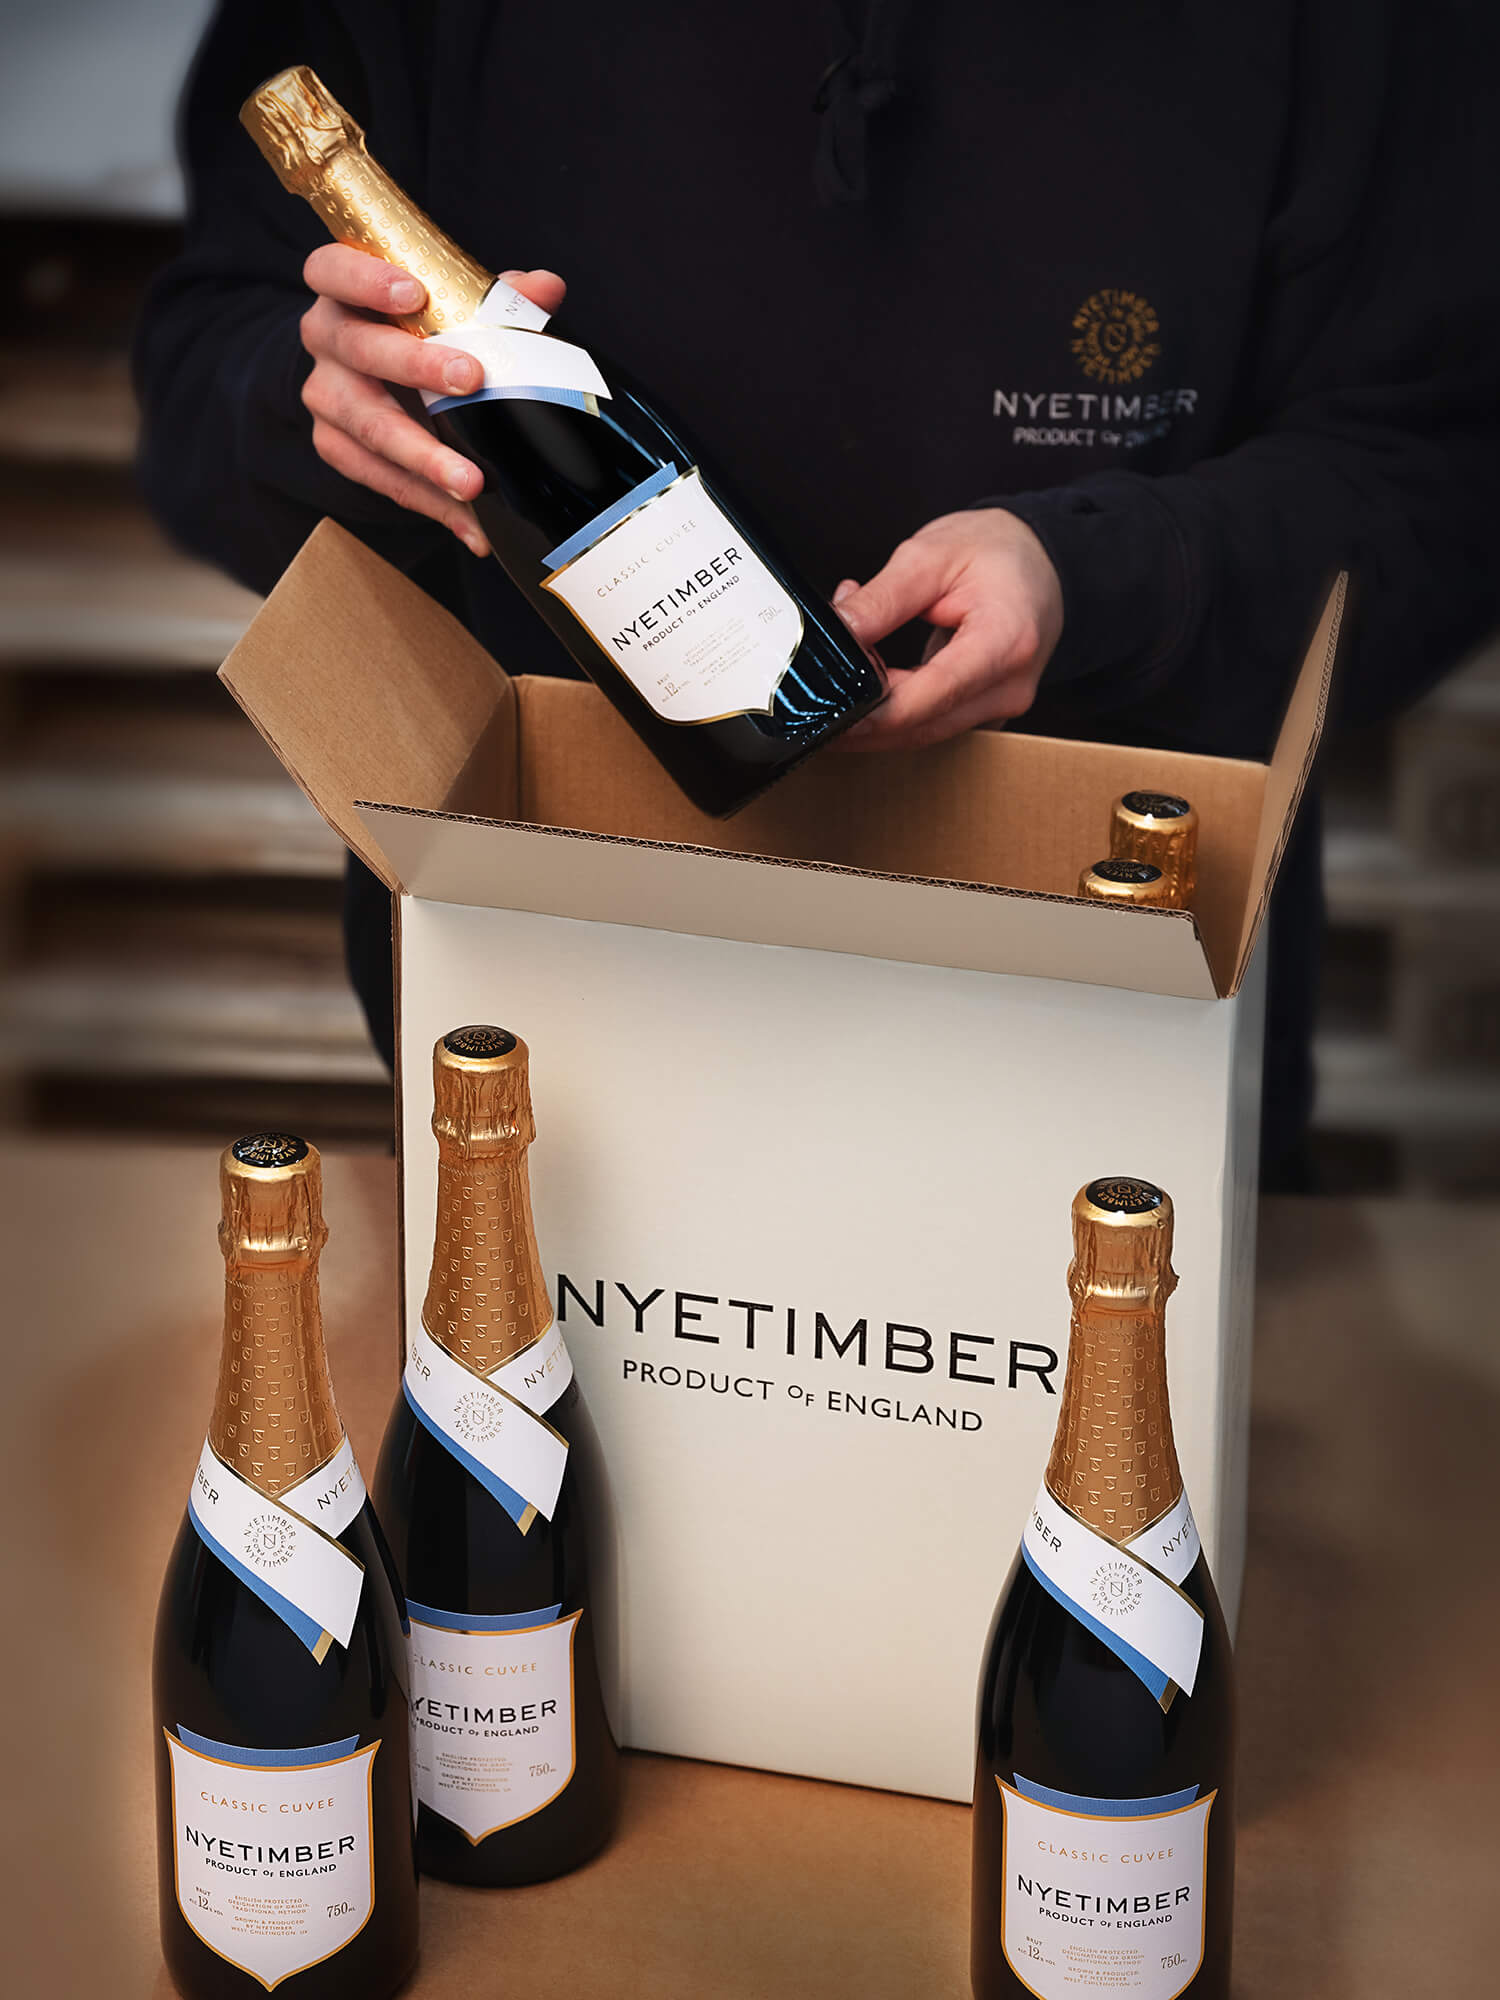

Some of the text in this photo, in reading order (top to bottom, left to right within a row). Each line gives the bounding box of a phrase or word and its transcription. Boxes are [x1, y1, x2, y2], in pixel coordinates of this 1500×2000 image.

[1013, 427, 1096, 446] PRODUCT
[596, 556, 649, 598] CLASSIC
[612, 547, 743, 651] NYETIMBER
[642, 616, 685, 651] PRODUCT
[698, 575, 741, 609] ENGLAND
[557, 1273, 1058, 1395] NYETIMBER
[623, 1360, 775, 1401] PRODUCT
[828, 1390, 983, 1432] ENGLAND
[484, 1662, 537, 1676] CUVEE
[413, 1697, 557, 1724] YETIMBER
[484, 1725, 540, 1737] ENGLAND
[200, 1791, 335, 1813] CLASSIC CUVEE
[185, 1825, 355, 1863] NYETIMBER
[1038, 1840, 1175, 1864] CLASSIC CUVEE
[205, 1857, 258, 1877] PRODUCT
[280, 1863, 337, 1878] ENGLAND
[1018, 1874, 1190, 1914] NYETIMBER
[1039, 1907, 1095, 1927] PRODUCT
[1116, 1914, 1173, 1929] ENGLAND
